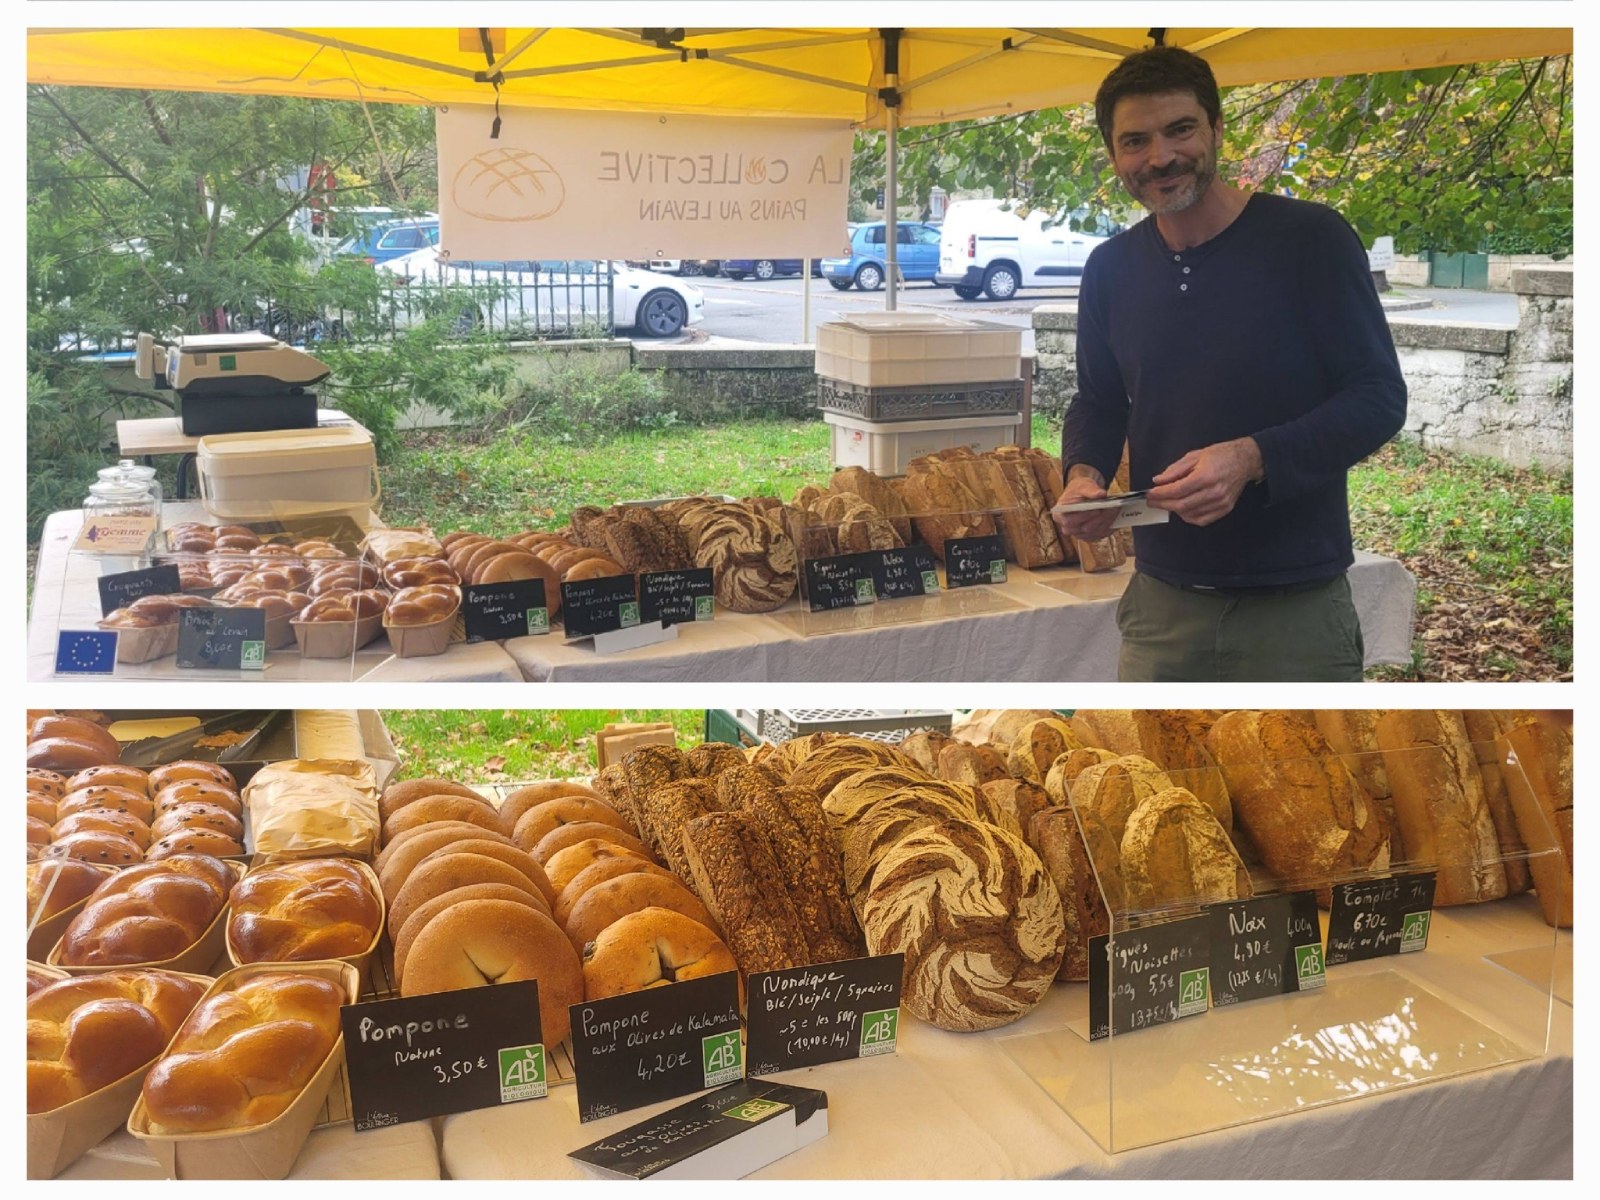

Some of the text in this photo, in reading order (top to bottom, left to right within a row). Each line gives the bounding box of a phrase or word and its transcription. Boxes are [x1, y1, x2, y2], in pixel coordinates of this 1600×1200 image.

[1344, 887, 1399, 911] Complet
[1229, 911, 1313, 938] Noix 400g
[1403, 921, 1423, 941] AB
[1131, 946, 1192, 974] Noisettes
[1300, 955, 1320, 977] AB
[763, 971, 845, 995] Nordique
[1182, 979, 1204, 1003] AB
[360, 1014, 469, 1047] Pompone
[582, 1008, 650, 1041] Pompone
[592, 1043, 616, 1055] aux
[669, 1022, 683, 1036] de
[688, 1005, 739, 1032] Kalamata
[816, 1014, 829, 1027] les
[864, 1020, 891, 1044] AB
[395, 1047, 442, 1067] Nature
[708, 1045, 736, 1072] AB
[505, 1057, 539, 1086] AB
[705, 1066, 742, 1079] AGRICULTURE
[503, 1083, 546, 1094] AGRICULTURE
[503, 1088, 546, 1099] BIOLOGIQUE
[357, 1117, 398, 1130] BOULANGER
